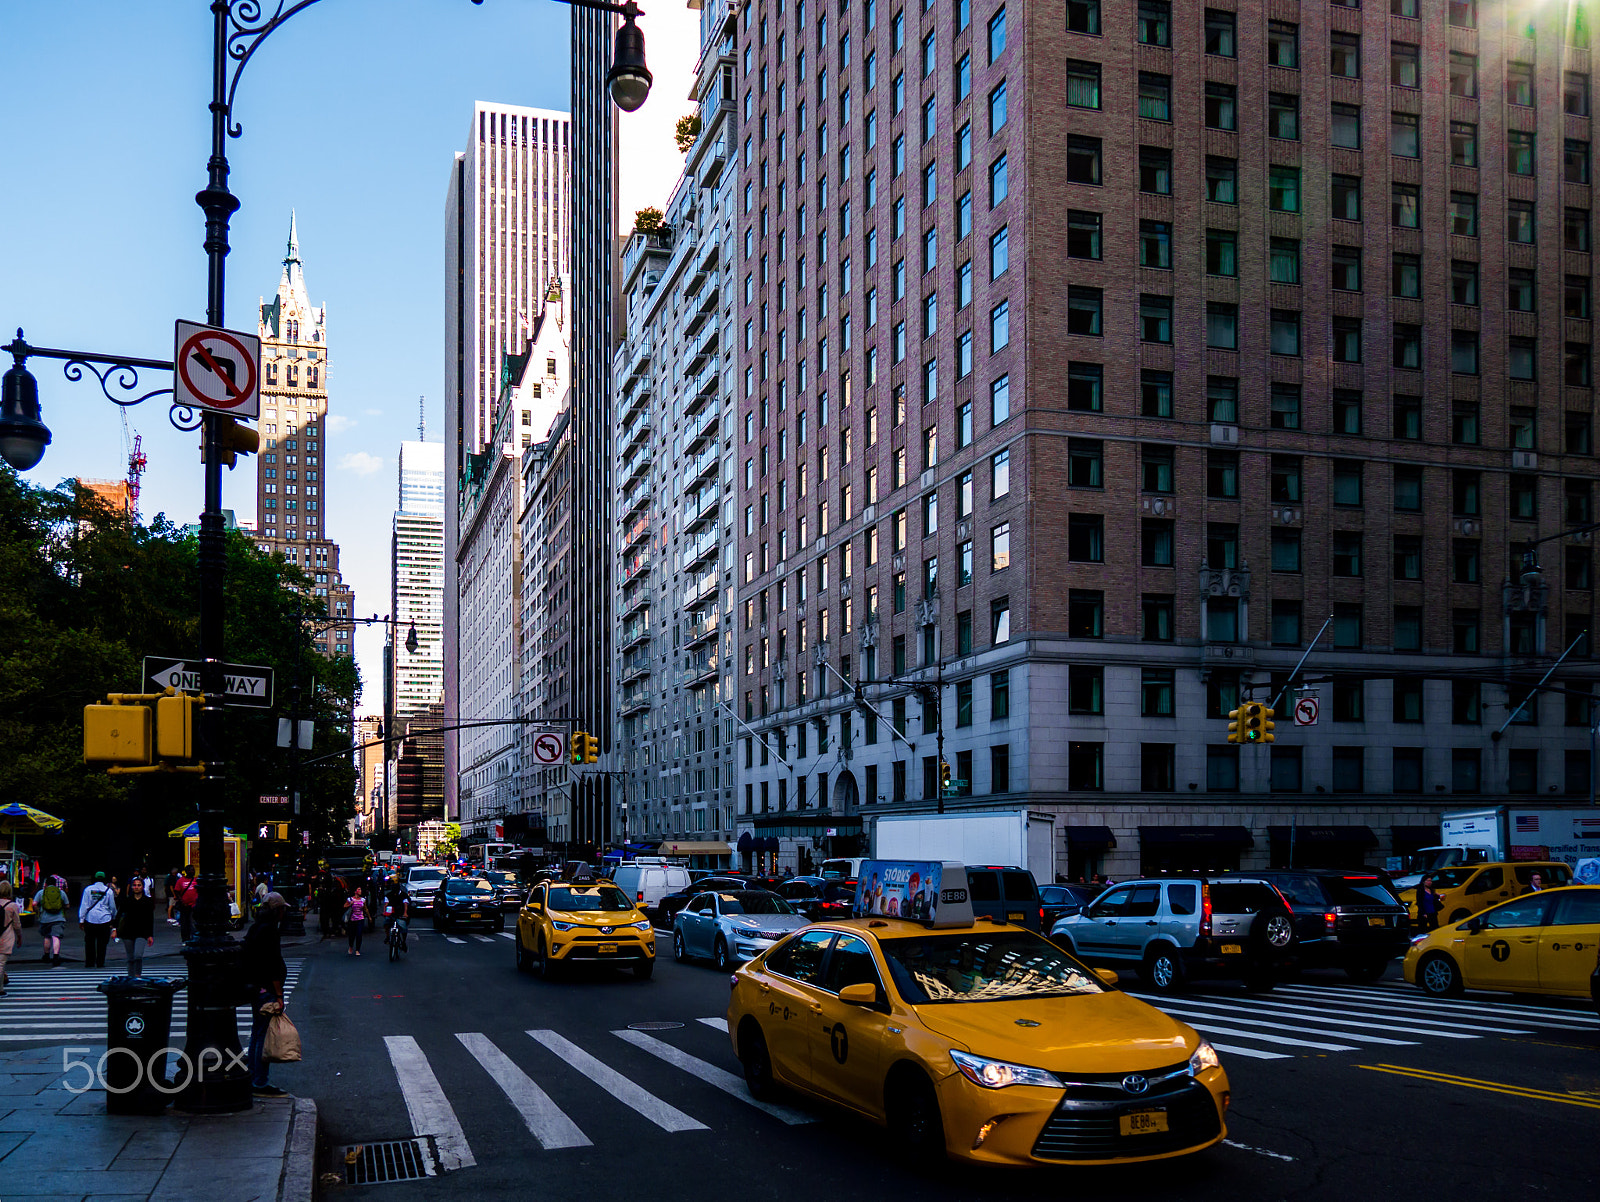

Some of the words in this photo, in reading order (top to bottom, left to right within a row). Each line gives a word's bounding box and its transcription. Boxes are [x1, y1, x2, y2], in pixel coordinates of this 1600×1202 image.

[169, 671, 200, 690] ONE
[224, 676, 260, 694] WAY
[1539, 844, 1578, 853] ersified
[883, 867, 911, 883] STORKS
[941, 891, 966, 901] 8E88
